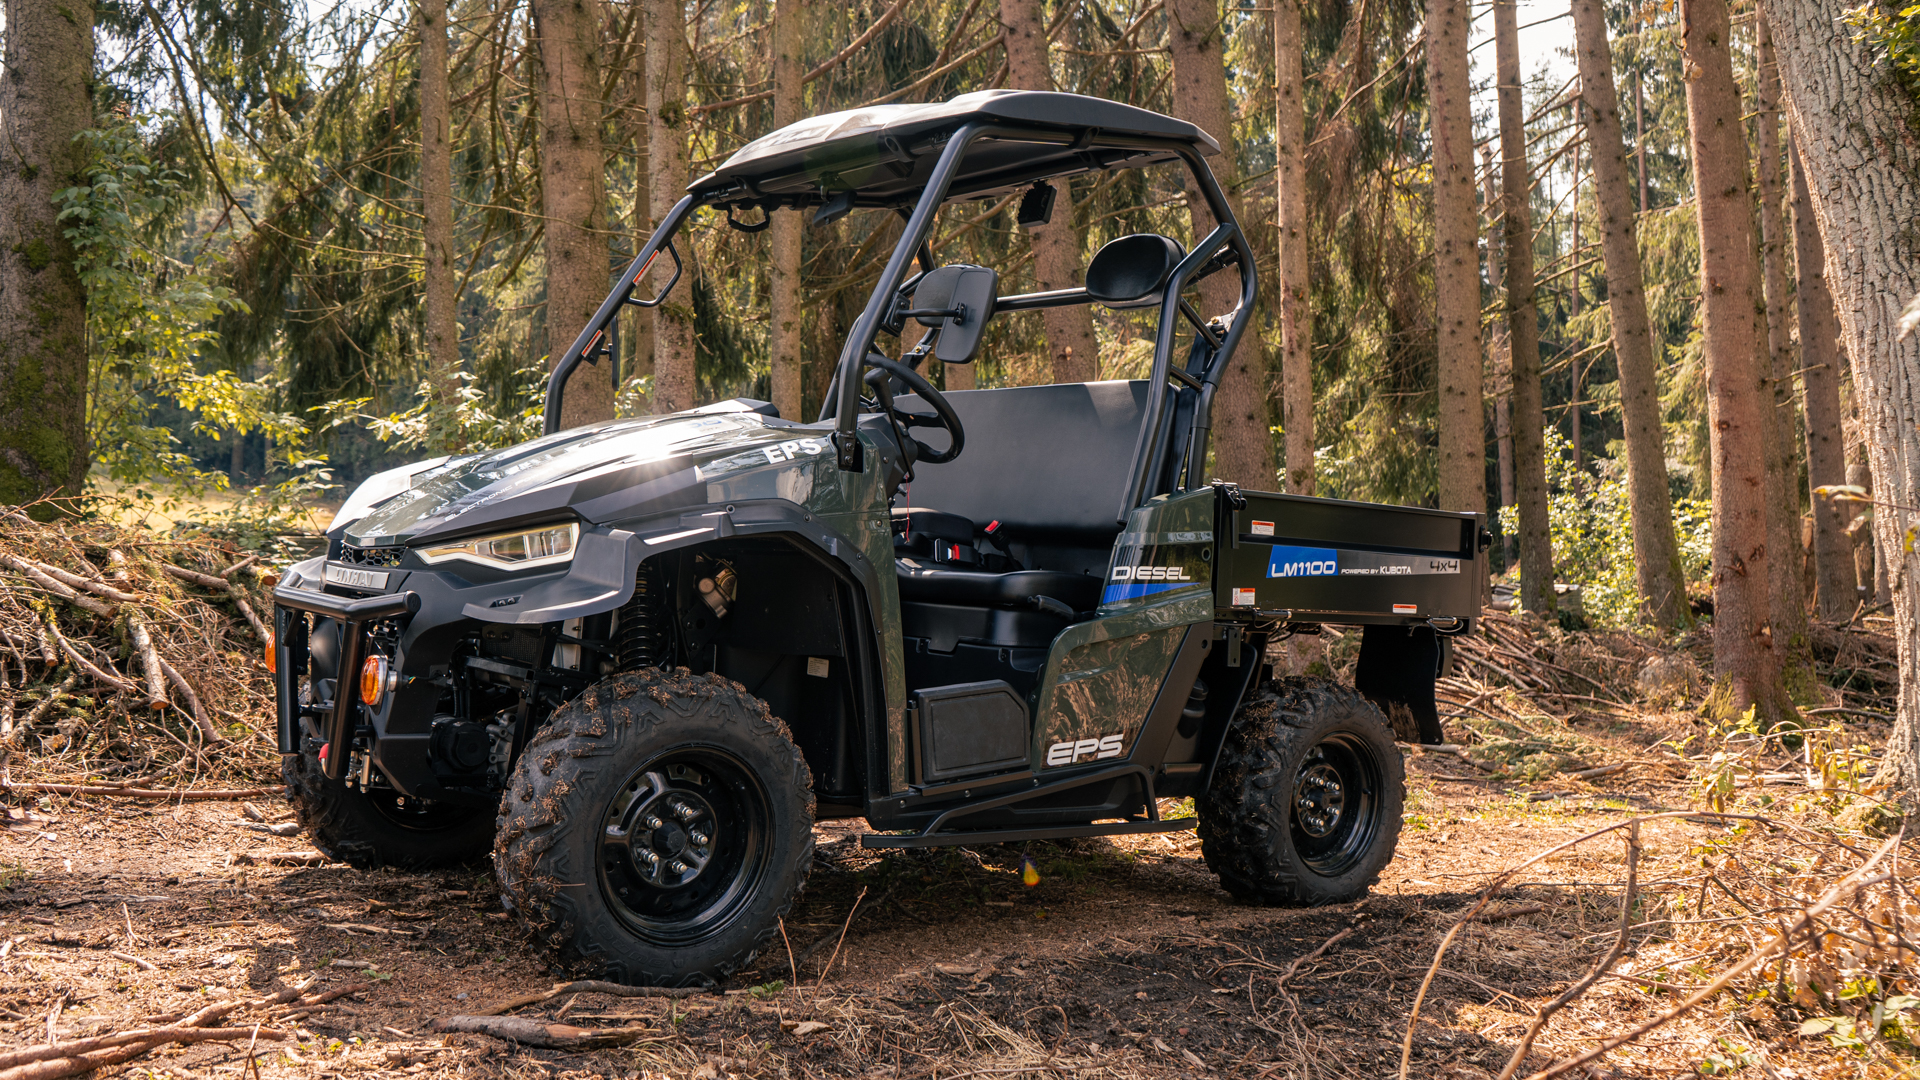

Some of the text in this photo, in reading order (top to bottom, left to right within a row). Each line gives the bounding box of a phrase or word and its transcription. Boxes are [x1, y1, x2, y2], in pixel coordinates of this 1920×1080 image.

[762, 438, 822, 464] EPS
[444, 485, 513, 521] ELECTRONIC
[1111, 565, 1191, 580] DIESEL
[1271, 561, 1336, 578] LM1100
[1380, 565, 1412, 575] KUBOTA
[1430, 560, 1458, 572] 4x4
[1046, 733, 1124, 766] EPS
